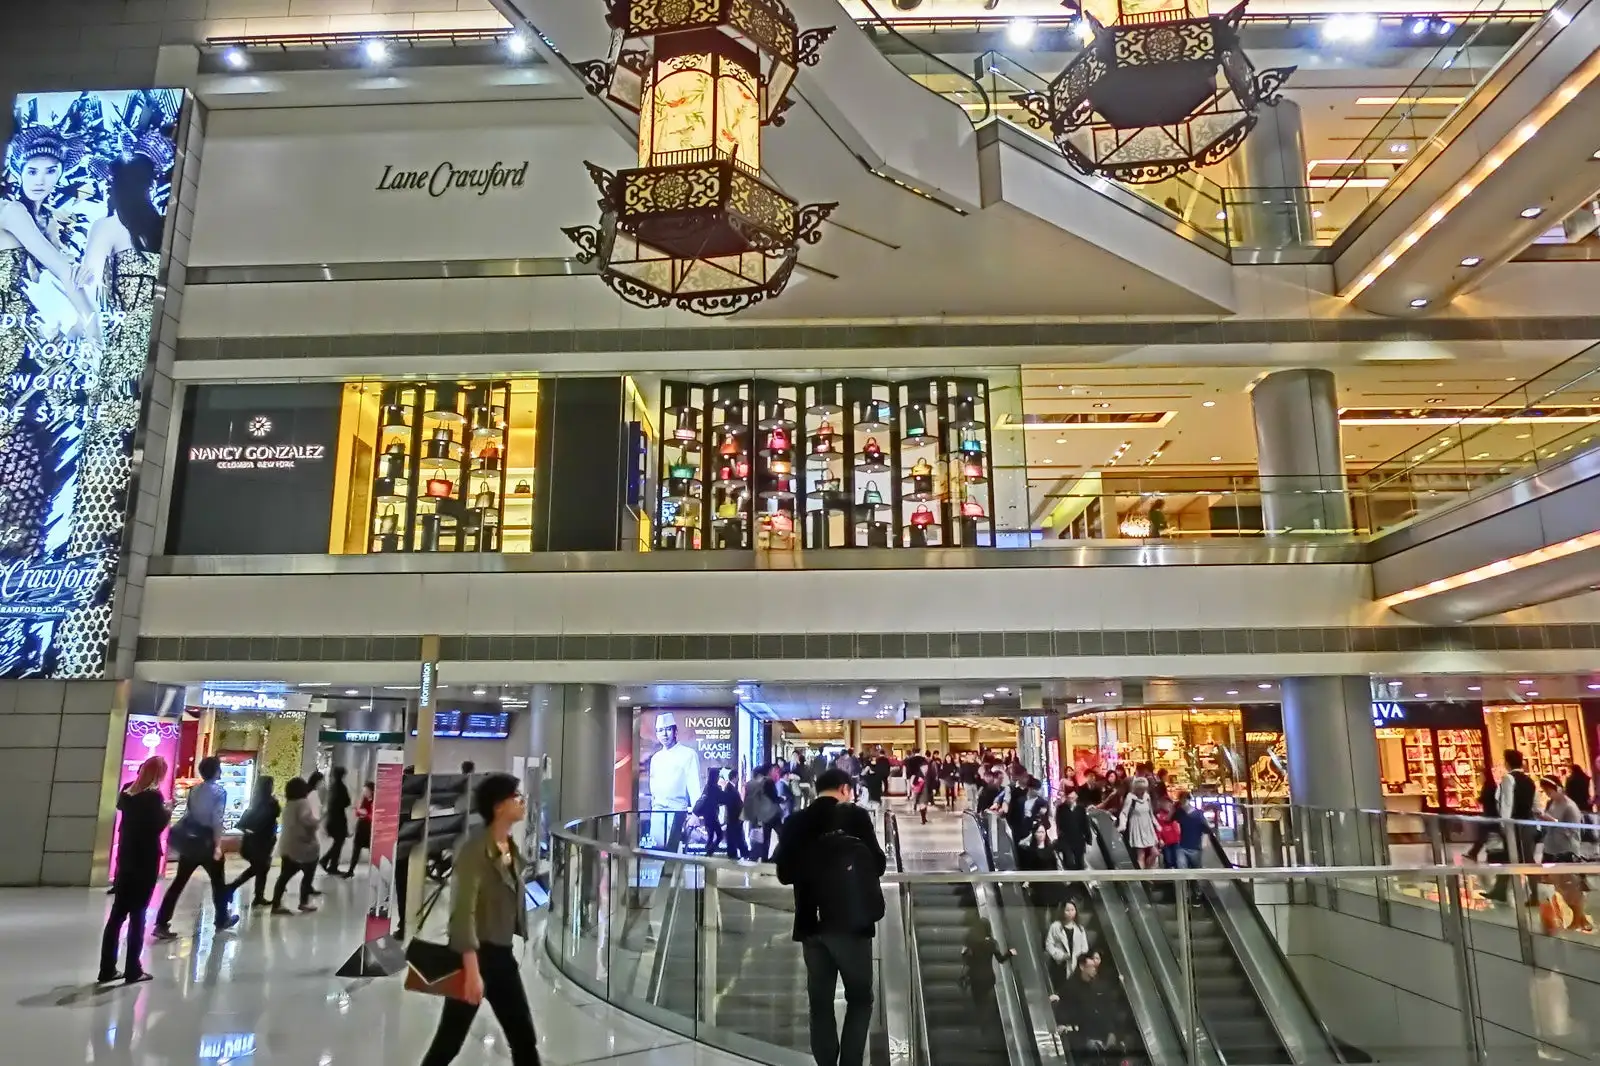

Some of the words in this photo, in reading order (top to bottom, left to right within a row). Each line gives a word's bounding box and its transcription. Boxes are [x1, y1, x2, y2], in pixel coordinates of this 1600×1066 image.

[375, 165, 429, 190] Lane
[428, 161, 529, 197] Crawford
[2, 311, 126, 328] DISVER
[12, 374, 98, 390] WORLD
[35, 404, 107, 422] STYLE
[190, 447, 242, 460] NANCY
[245, 446, 324, 460] GONZALEZ
[685, 717, 731, 728] INAGIKU
[696, 738, 731, 751] TAKASHI
